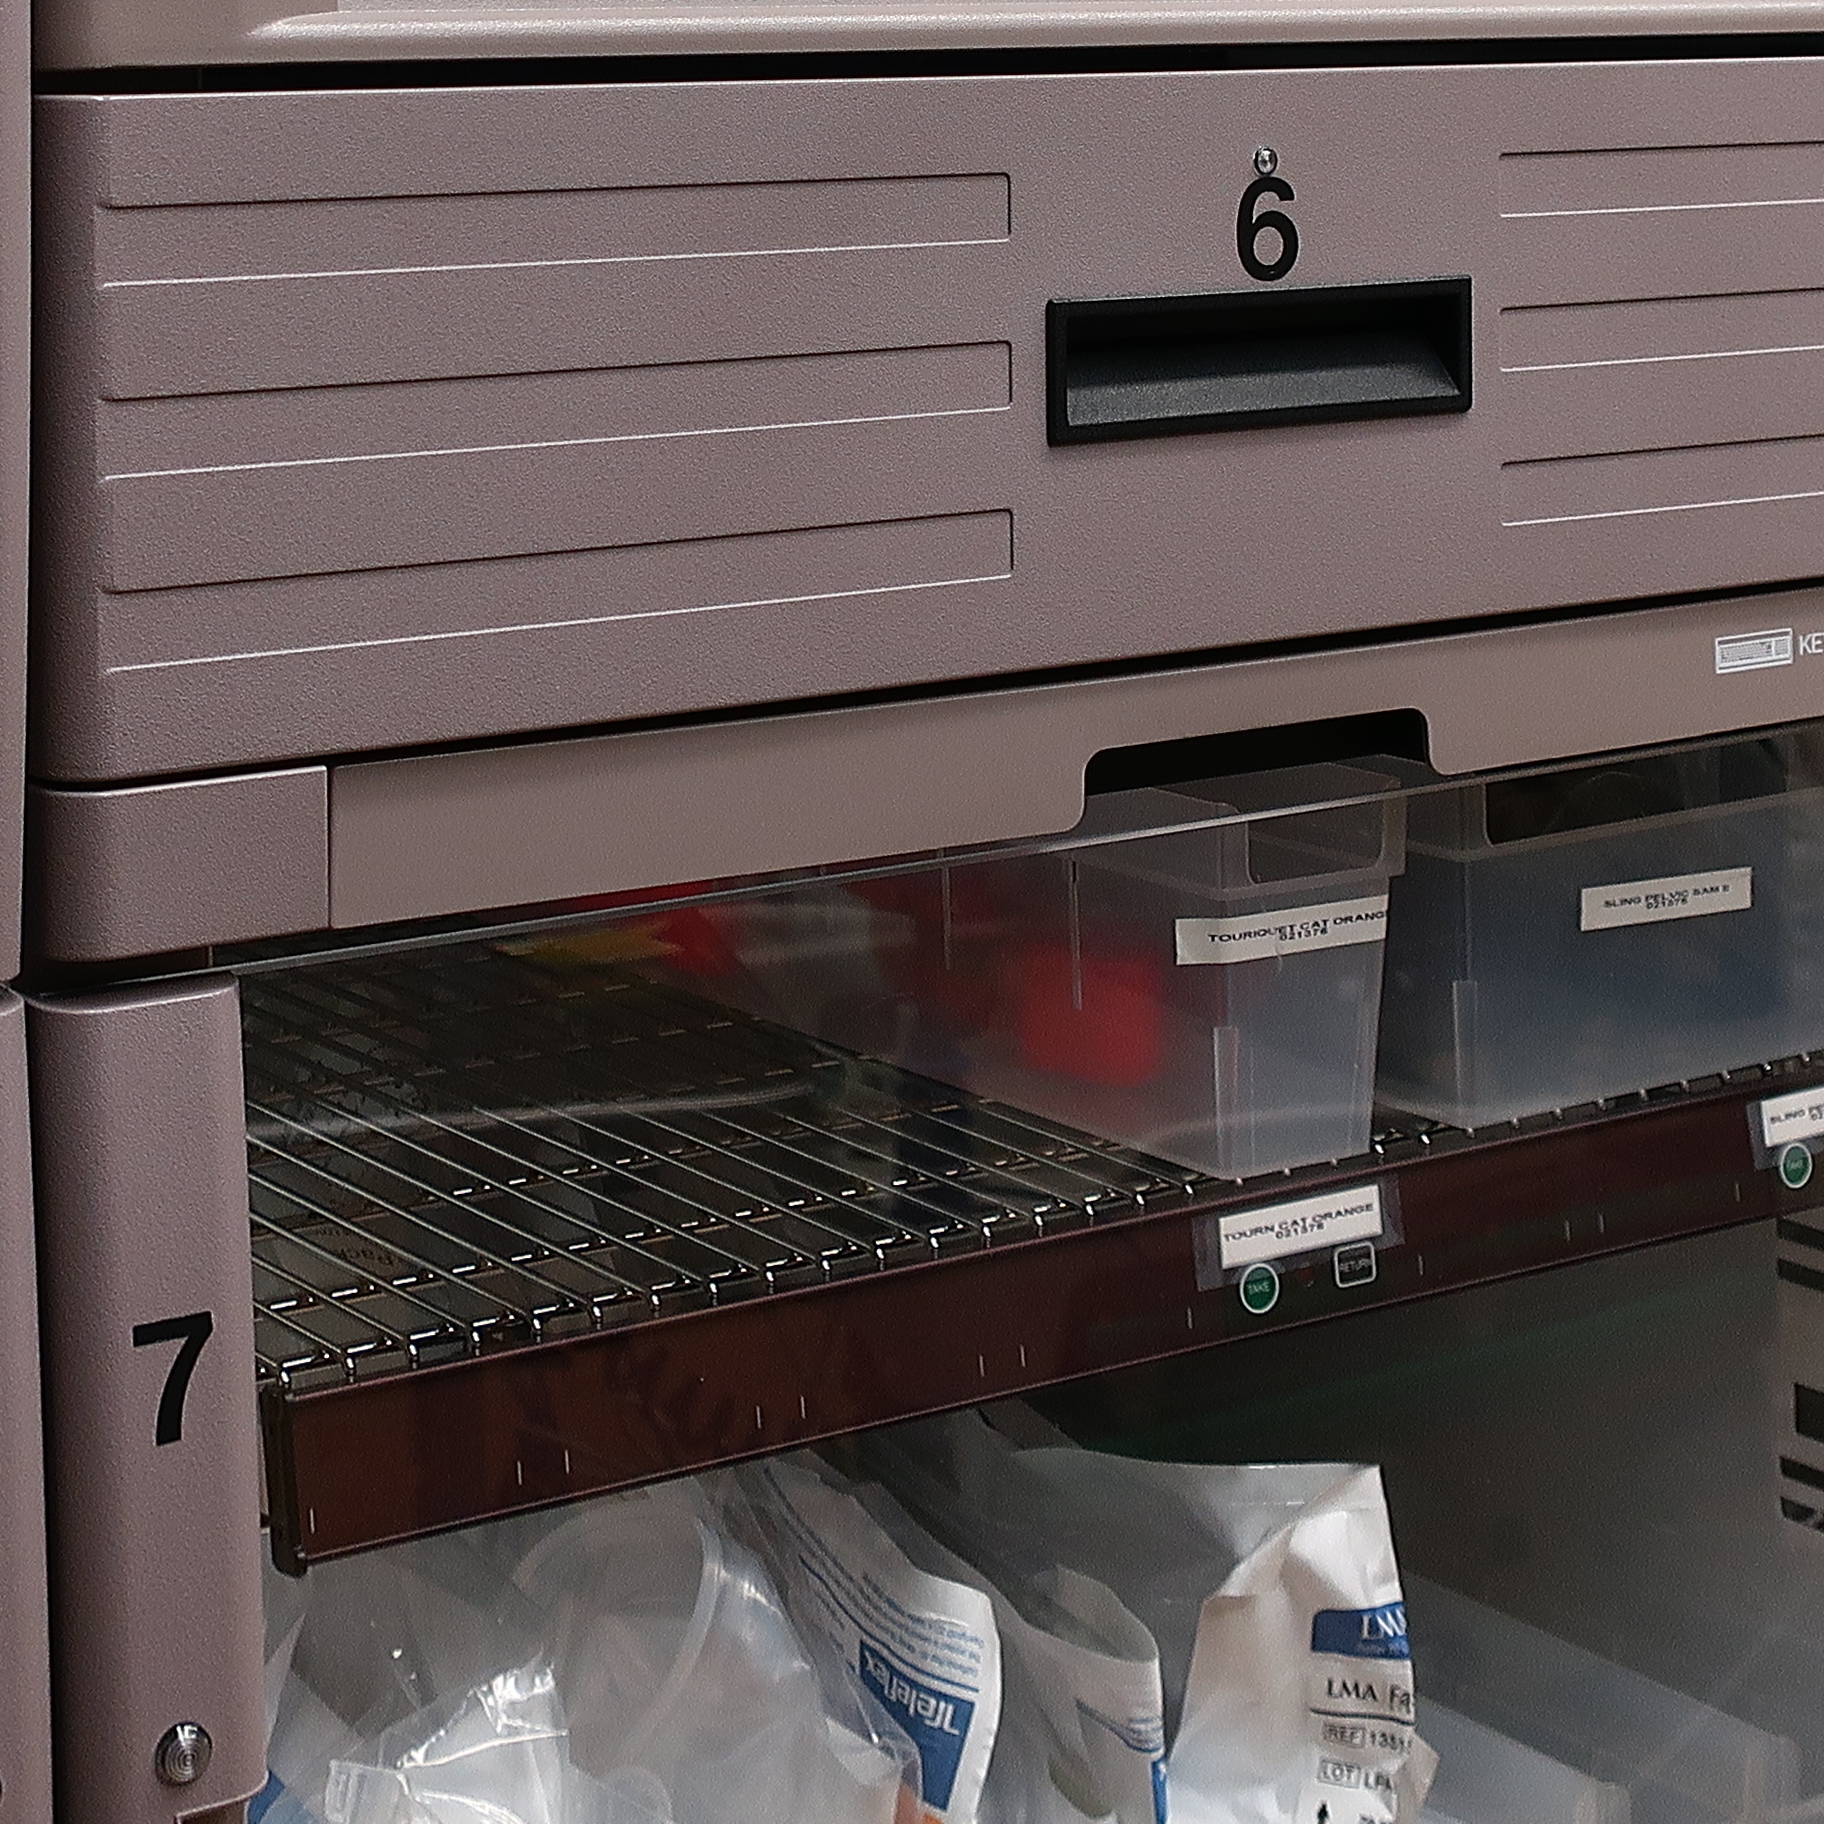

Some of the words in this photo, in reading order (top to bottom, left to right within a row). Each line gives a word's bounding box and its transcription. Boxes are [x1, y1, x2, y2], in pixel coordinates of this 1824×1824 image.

[1235, 176, 1300, 282] 6
[1604, 896, 1641, 908] SLING
[1645, 890, 1688, 903] PELVIC
[1693, 886, 1719, 896] SAM
[1300, 919, 1329, 930] CAT
[1224, 1225, 1274, 1242] TOURN
[1277, 1218, 1306, 1230] CAT
[1312, 1203, 1374, 1223] ORANGE
[132, 1310, 213, 1446] 7
[863, 1650, 960, 1736] Teleflex
[1327, 1678, 1379, 1703] LMA
[1327, 1728, 1359, 1745] REF
[1323, 1763, 1358, 1783] LOT
